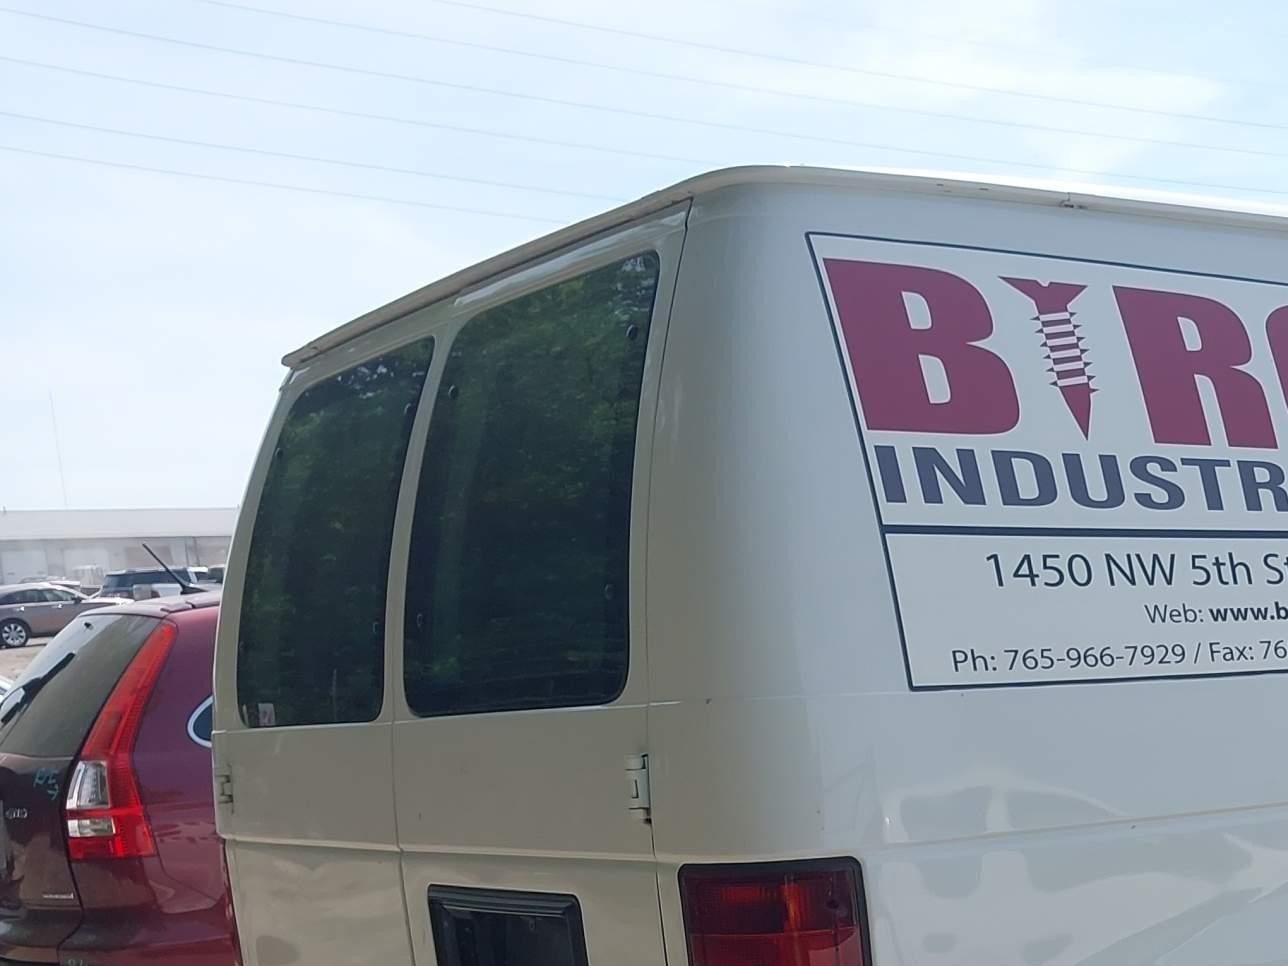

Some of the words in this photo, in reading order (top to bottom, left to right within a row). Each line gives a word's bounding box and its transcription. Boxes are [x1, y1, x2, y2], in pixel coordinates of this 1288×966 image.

[985, 552, 1093, 588] 1450
[1104, 552, 1176, 587] NW
[1190, 551, 1254, 587] 5th
[1144, 603, 1204, 624] Web:
[951, 648, 998, 673] Ph:
[1003, 643, 1187, 672] 765-966-7929
[1193, 641, 1202, 665] /
[1208, 641, 1255, 663] Fax:
